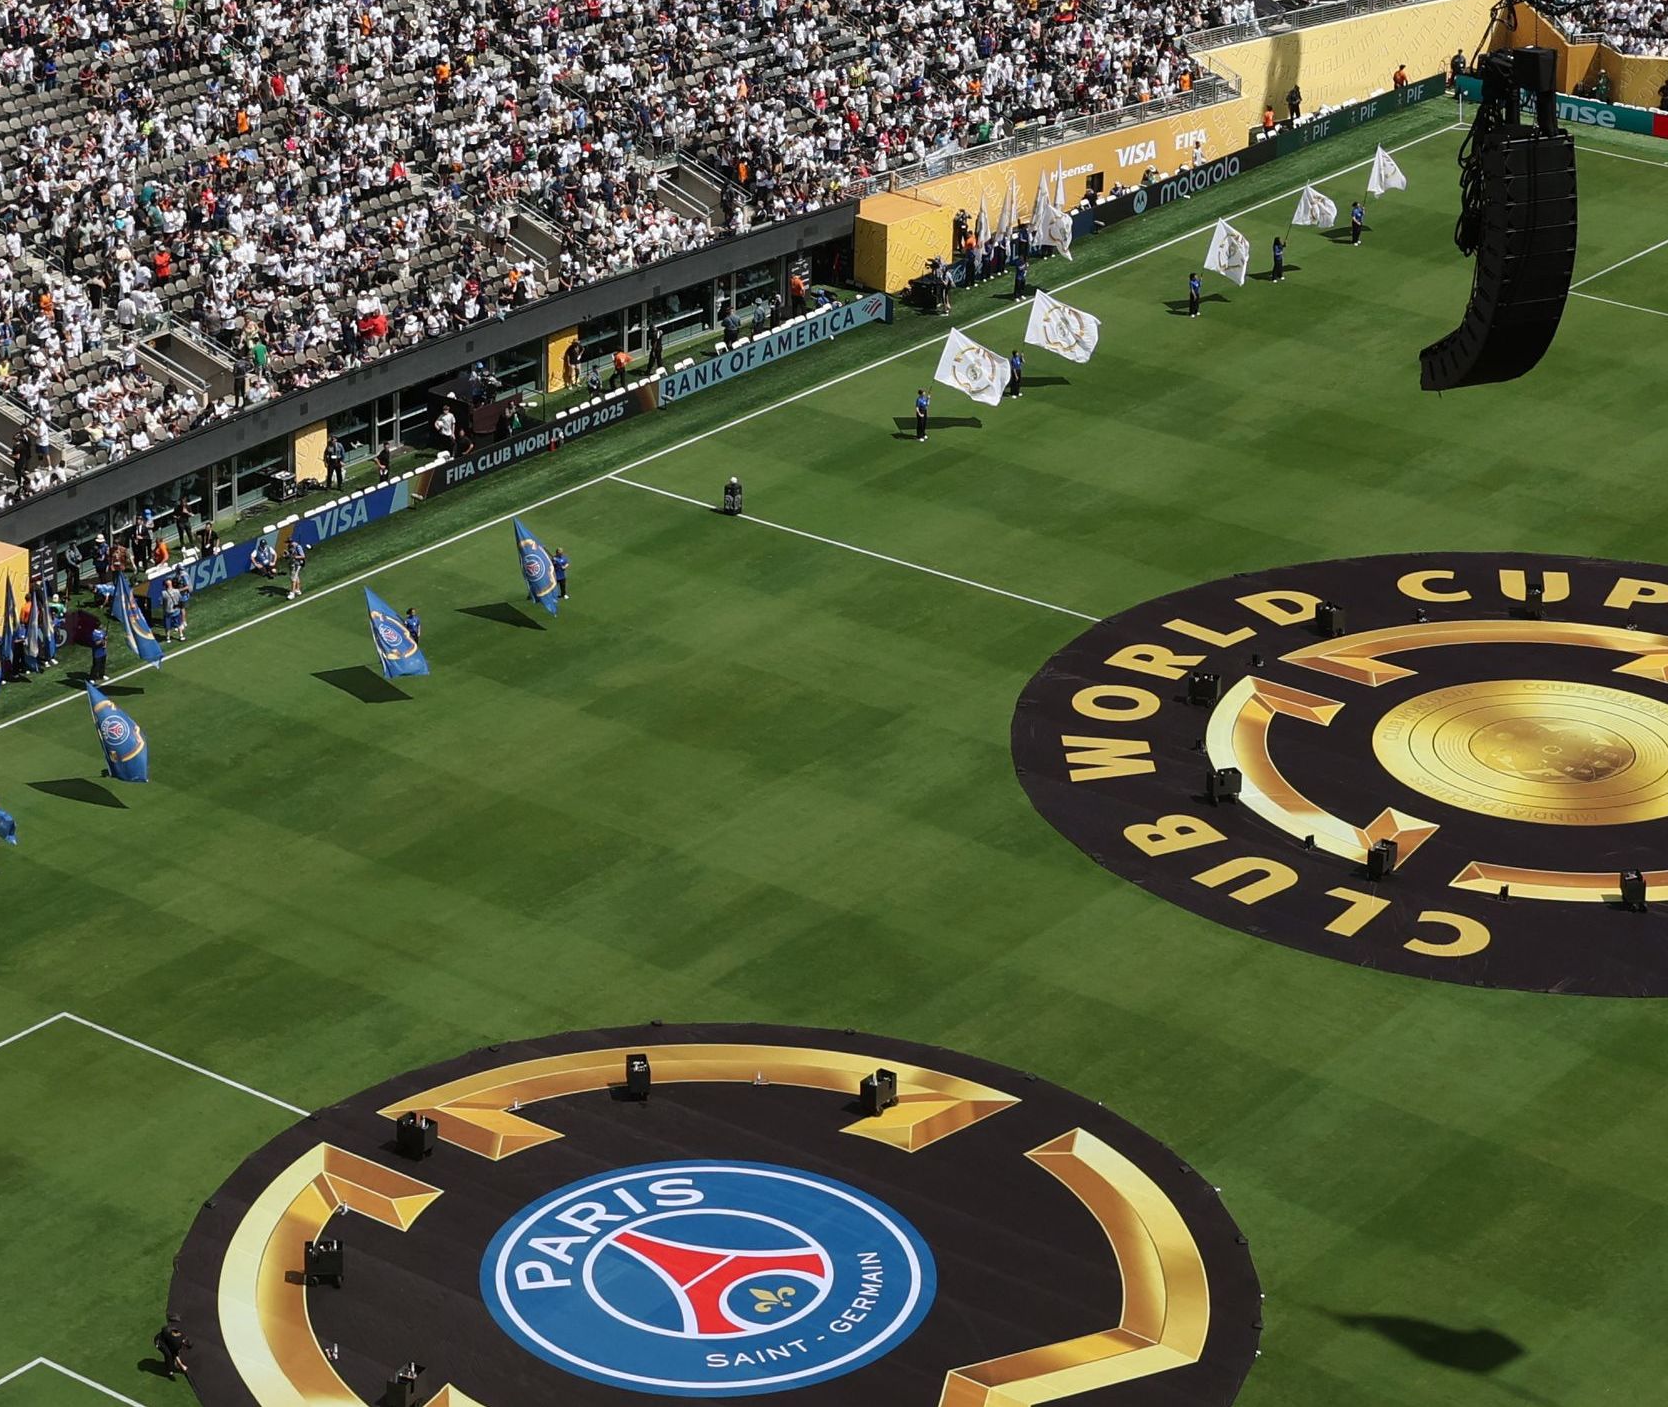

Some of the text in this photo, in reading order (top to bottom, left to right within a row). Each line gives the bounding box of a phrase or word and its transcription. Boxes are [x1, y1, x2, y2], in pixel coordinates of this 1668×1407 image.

[1359, 101, 1378, 122] PIF
[1405, 84, 1425, 104] PIF
[1174, 127, 1208, 151] FIFA
[1311, 120, 1332, 140] PIF
[1049, 162, 1094, 183] Hsense
[1115, 140, 1158, 168] VISA
[1159, 154, 1242, 206] motorola
[665, 306, 856, 399] BANK OF AMERICA
[445, 415, 592, 486] FIFA CLUB WORLD CUP
[312, 502, 369, 541] VISA
[1068, 589, 1324, 783] WORLD
[1122, 812, 1491, 959] CLUB
[513, 1177, 705, 1291] PARIS
[828, 1251, 879, 1334] GERMAIN
[705, 1338, 808, 1369] SAINT
